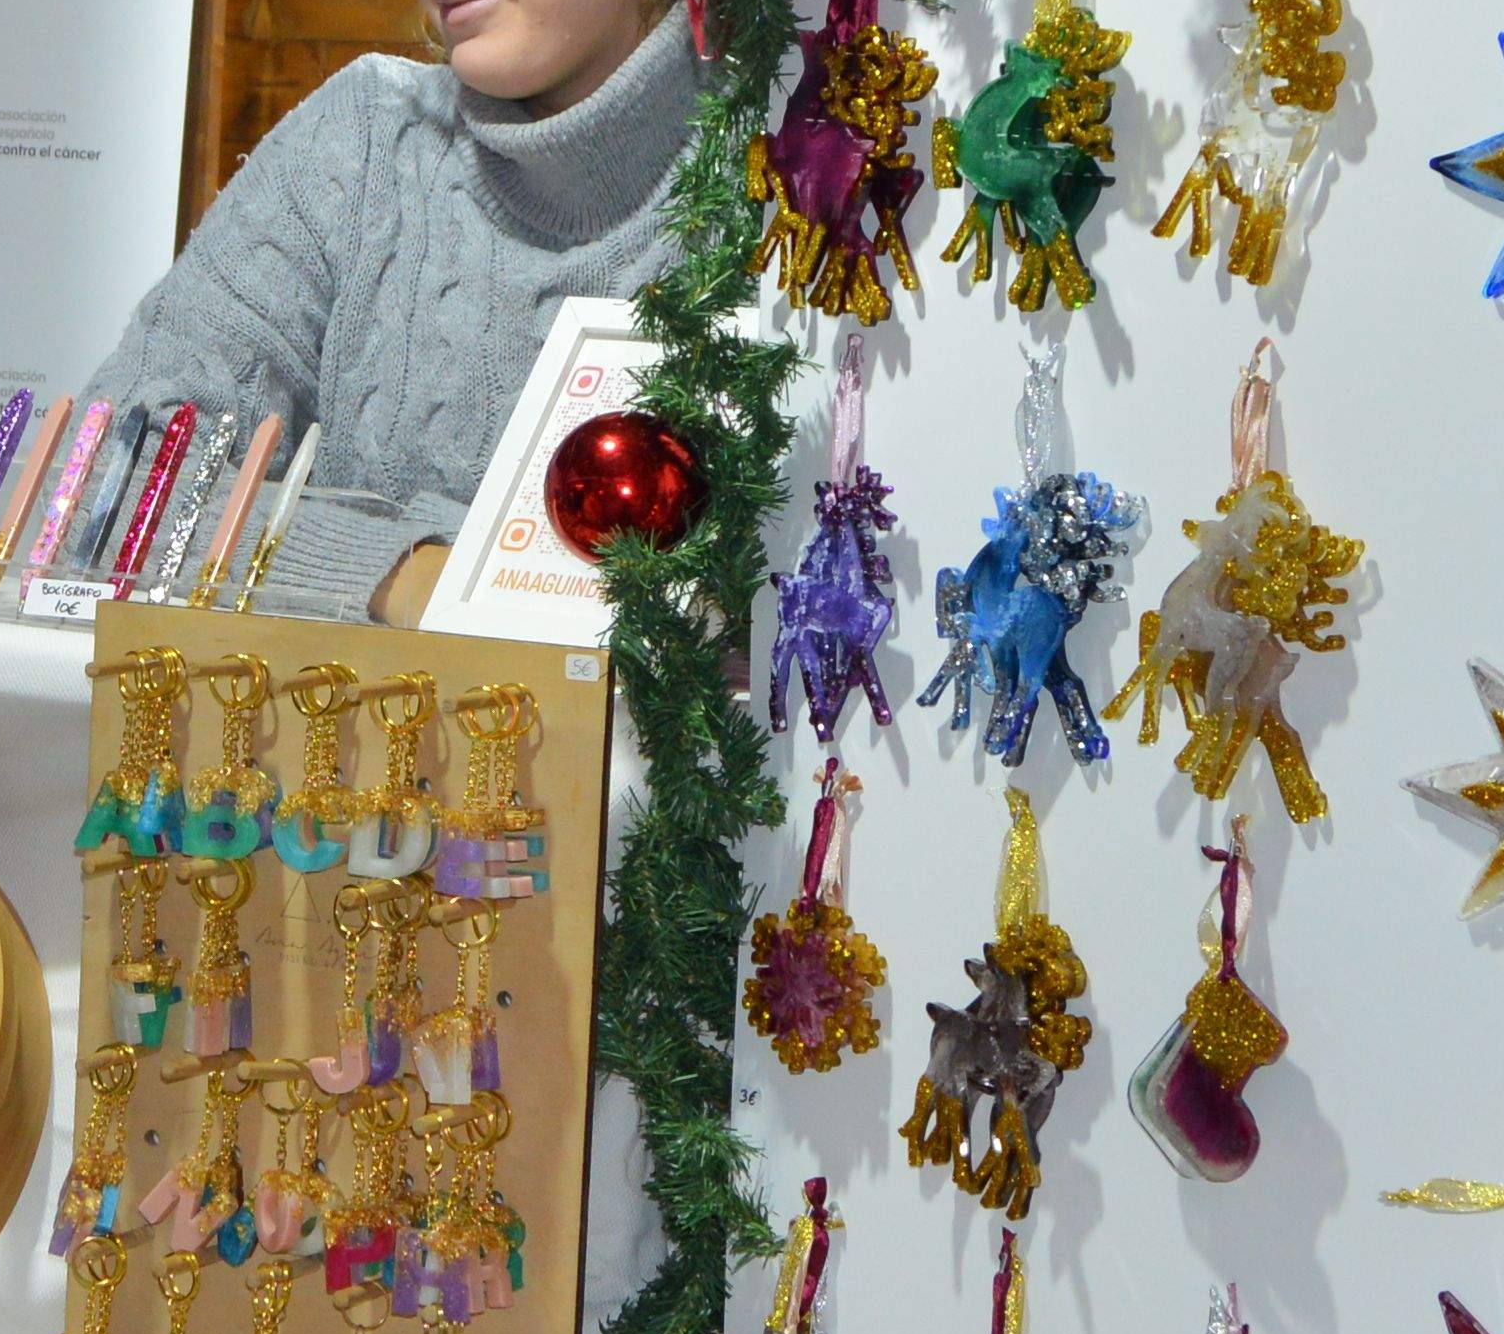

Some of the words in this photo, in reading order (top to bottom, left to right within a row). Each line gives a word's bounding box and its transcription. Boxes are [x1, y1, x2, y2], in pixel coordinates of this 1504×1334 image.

[39, 144, 51, 157] el
[54, 146, 102, 162] cáncer
[55, 599, 81, 616] 10€
[571, 659, 592, 677] 5€
